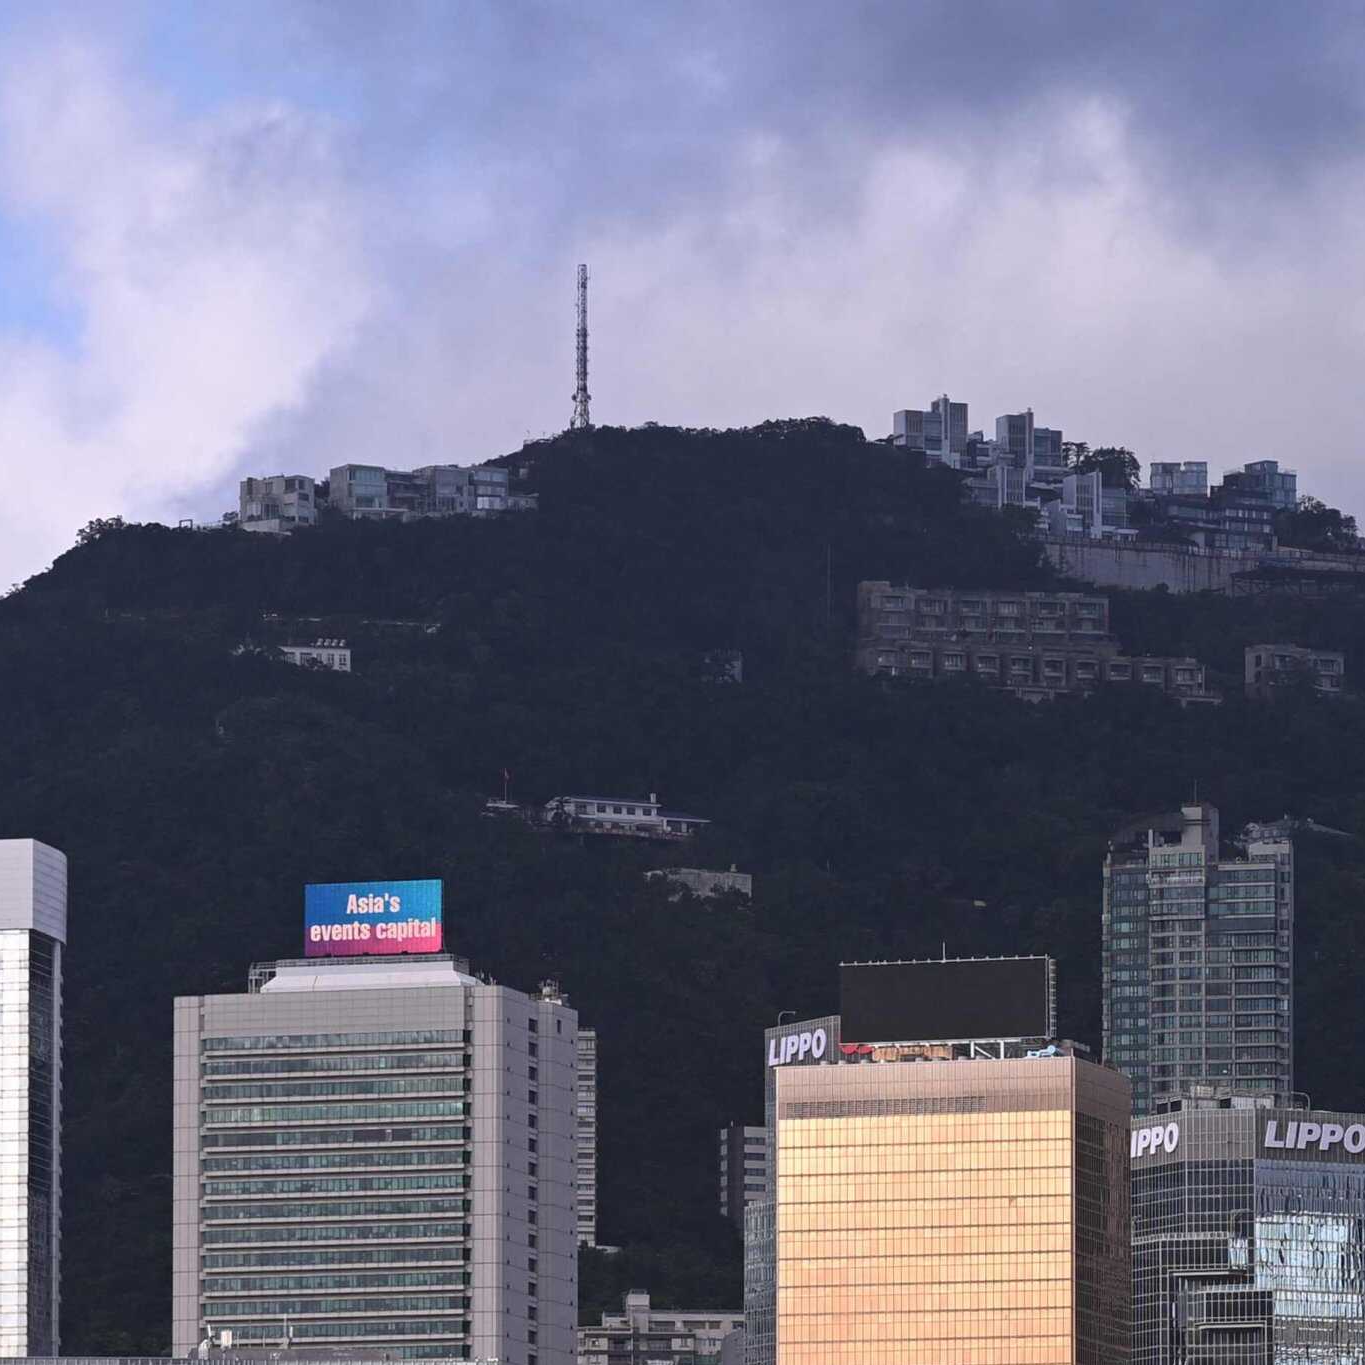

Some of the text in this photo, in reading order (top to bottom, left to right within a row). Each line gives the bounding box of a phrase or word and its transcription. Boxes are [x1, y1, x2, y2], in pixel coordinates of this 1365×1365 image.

[346, 893, 401, 914] Asia's
[310, 917, 436, 942] events capital
[768, 1028, 827, 1068] LIPPO
